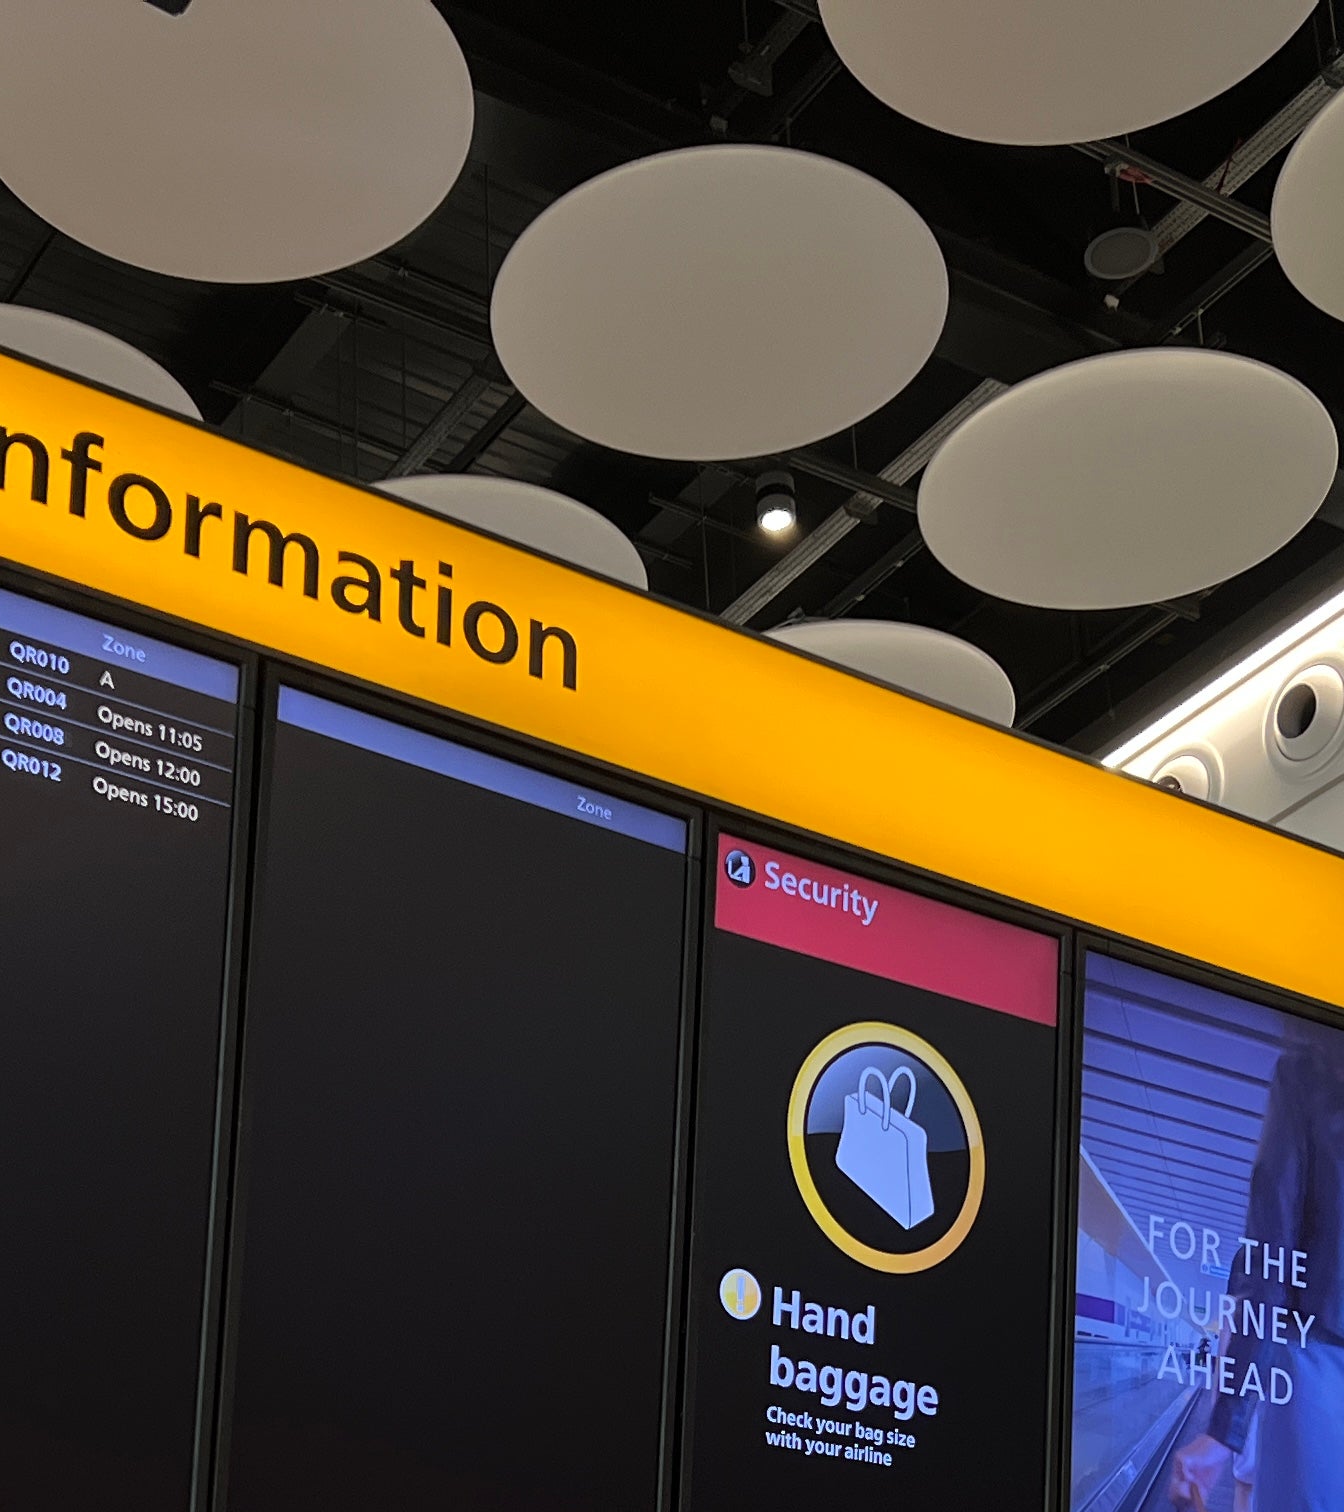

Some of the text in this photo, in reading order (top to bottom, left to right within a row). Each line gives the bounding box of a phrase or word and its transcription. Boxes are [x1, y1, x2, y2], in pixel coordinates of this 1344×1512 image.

[9, 640, 115, 690] QR010 A
[102, 634, 146, 663] Zone
[6, 676, 203, 752] QR004 Opens 11:05
[4, 712, 201, 787] QR008 Opens 12:00
[1, 748, 199, 822] QR012 Opens 15:00
[576, 795, 613, 821] Zone
[763, 859, 880, 927] Security
[1149, 1214, 1307, 1289] FOR THE
[772, 1286, 876, 1345] Hand
[1137, 1276, 1316, 1349] JOURNEY
[769, 1344, 939, 1421] baggage
[1157, 1342, 1293, 1406] AHEAD
[765, 1430, 892, 1467] with your airline
[766, 1405, 916, 1448] Check your bag size
